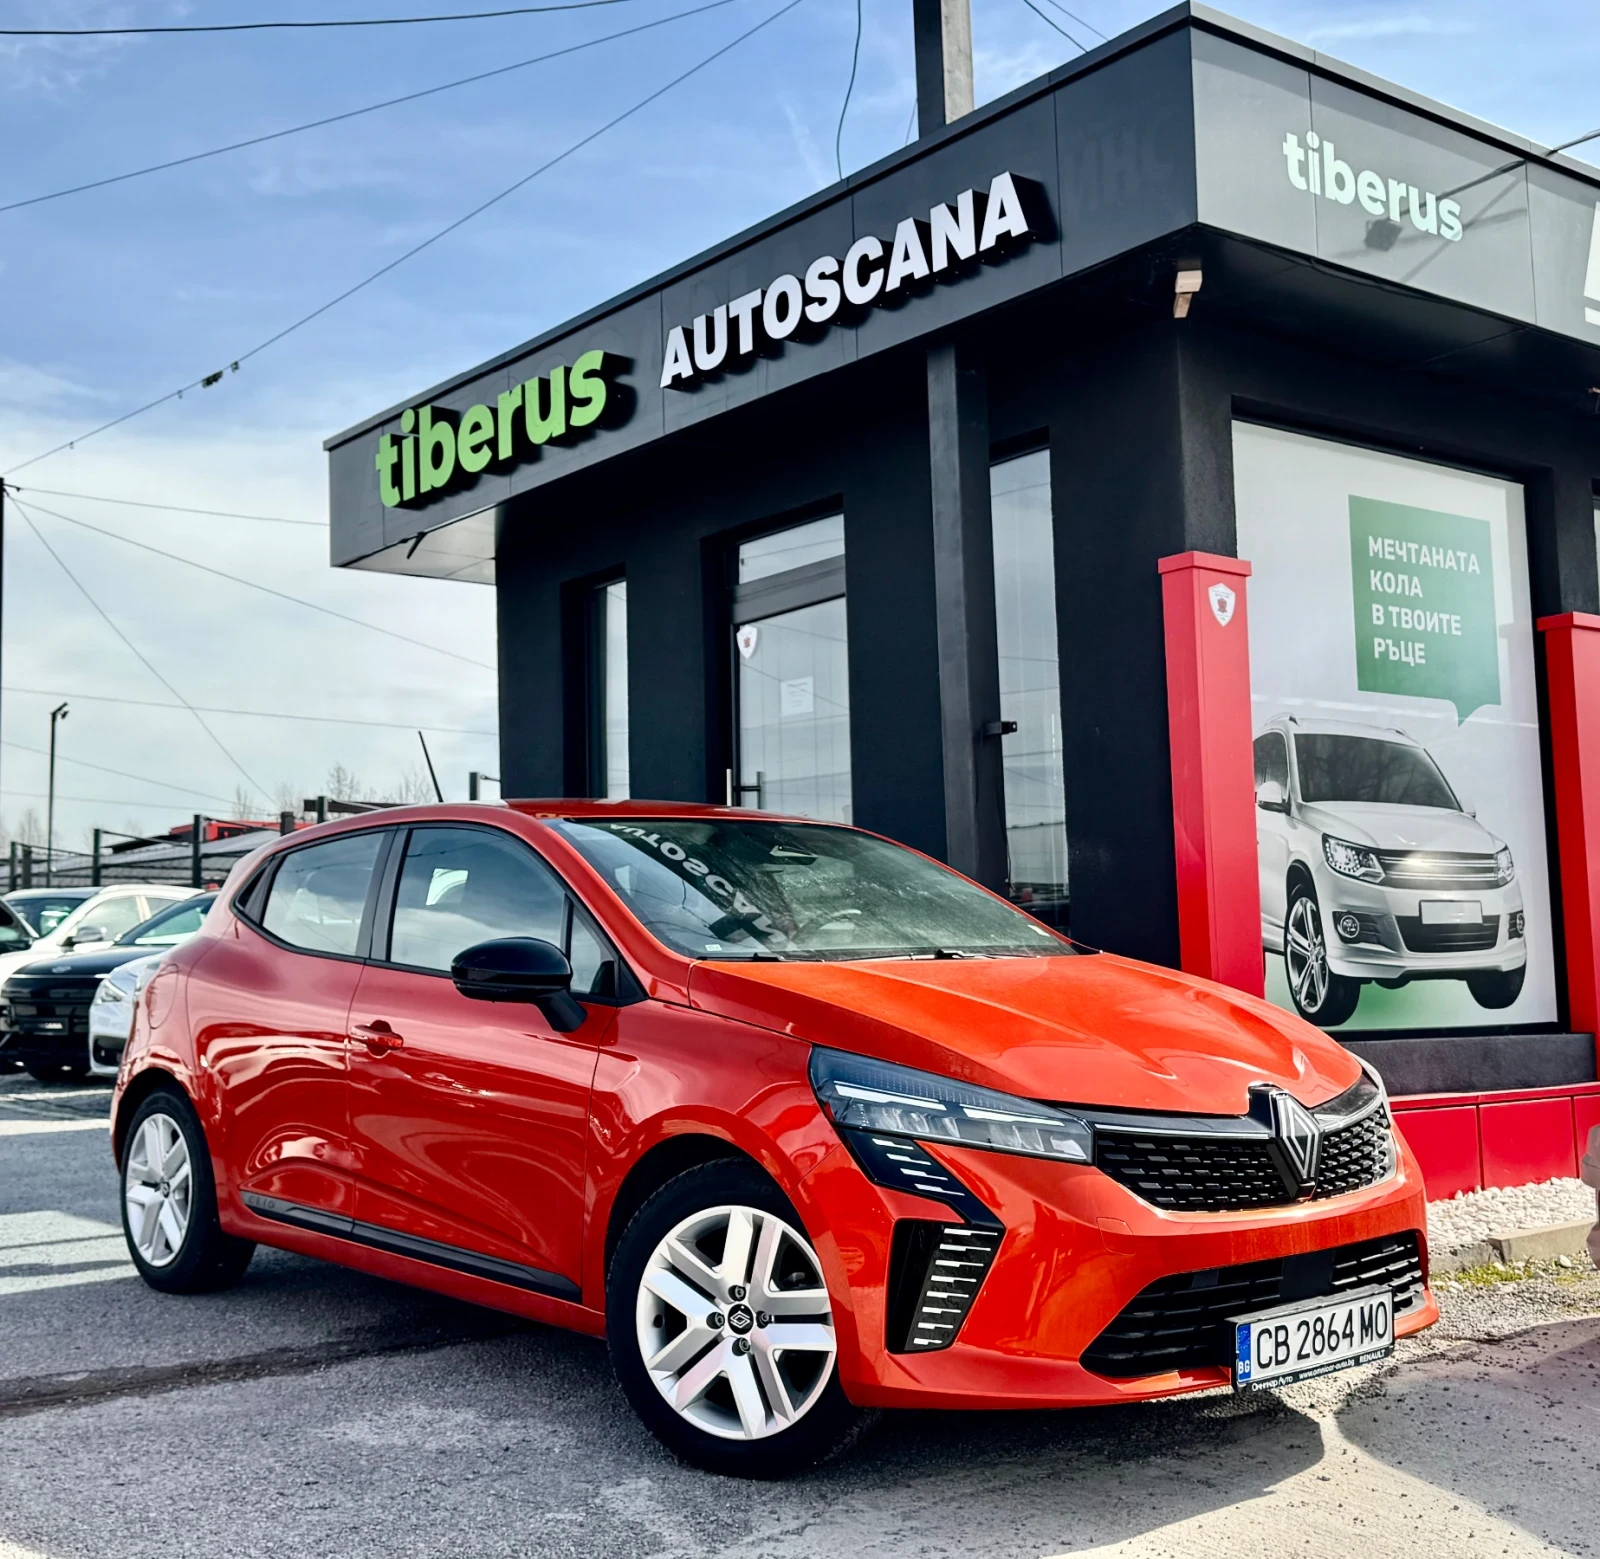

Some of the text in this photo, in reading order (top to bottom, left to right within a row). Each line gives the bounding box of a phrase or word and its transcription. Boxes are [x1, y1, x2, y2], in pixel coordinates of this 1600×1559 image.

[1282, 131, 1464, 242] tiberus
[659, 170, 1031, 390] AUTOSCANA
[374, 349, 607, 508] tiberus
[1368, 535, 1481, 575] МЕЧТАНАТА
[1370, 569, 1423, 598] КОЛА
[1371, 603, 1462, 636] В ТВОИТЕ
[1373, 637, 1426, 667] РЪЦЕ
[248, 1195, 276, 1210] CLIO
[1296, 1308, 1354, 1361] 2864
[1238, 1360, 1251, 1374] BG
[1359, 1349, 1386, 1364] RENAULT
